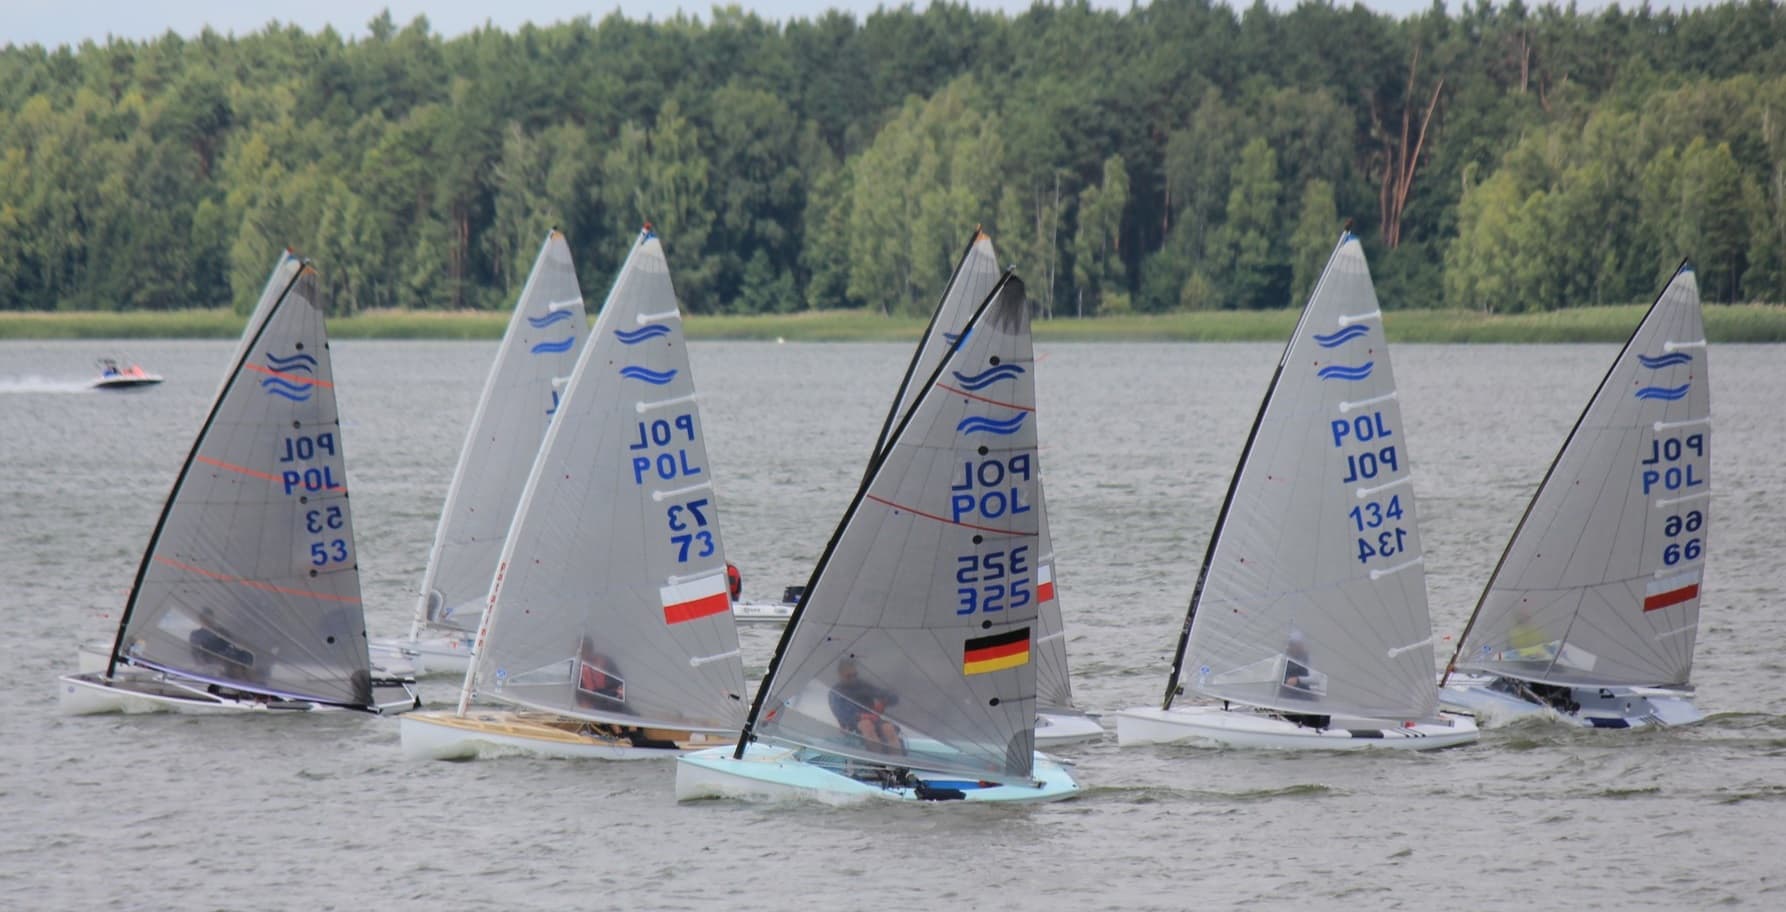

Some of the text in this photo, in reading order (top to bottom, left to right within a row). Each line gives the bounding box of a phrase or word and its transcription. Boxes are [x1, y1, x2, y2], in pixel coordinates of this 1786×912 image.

[1331, 411, 1391, 447] POL
[283, 465, 339, 495] POL
[632, 449, 701, 484] POL
[1643, 464, 1702, 494] POL
[952, 487, 1030, 523] POL
[1349, 495, 1403, 531] 134
[311, 539, 348, 564] 53
[671, 530, 715, 562] 73
[1664, 539, 1701, 565] 66
[957, 578, 1030, 615] 325
